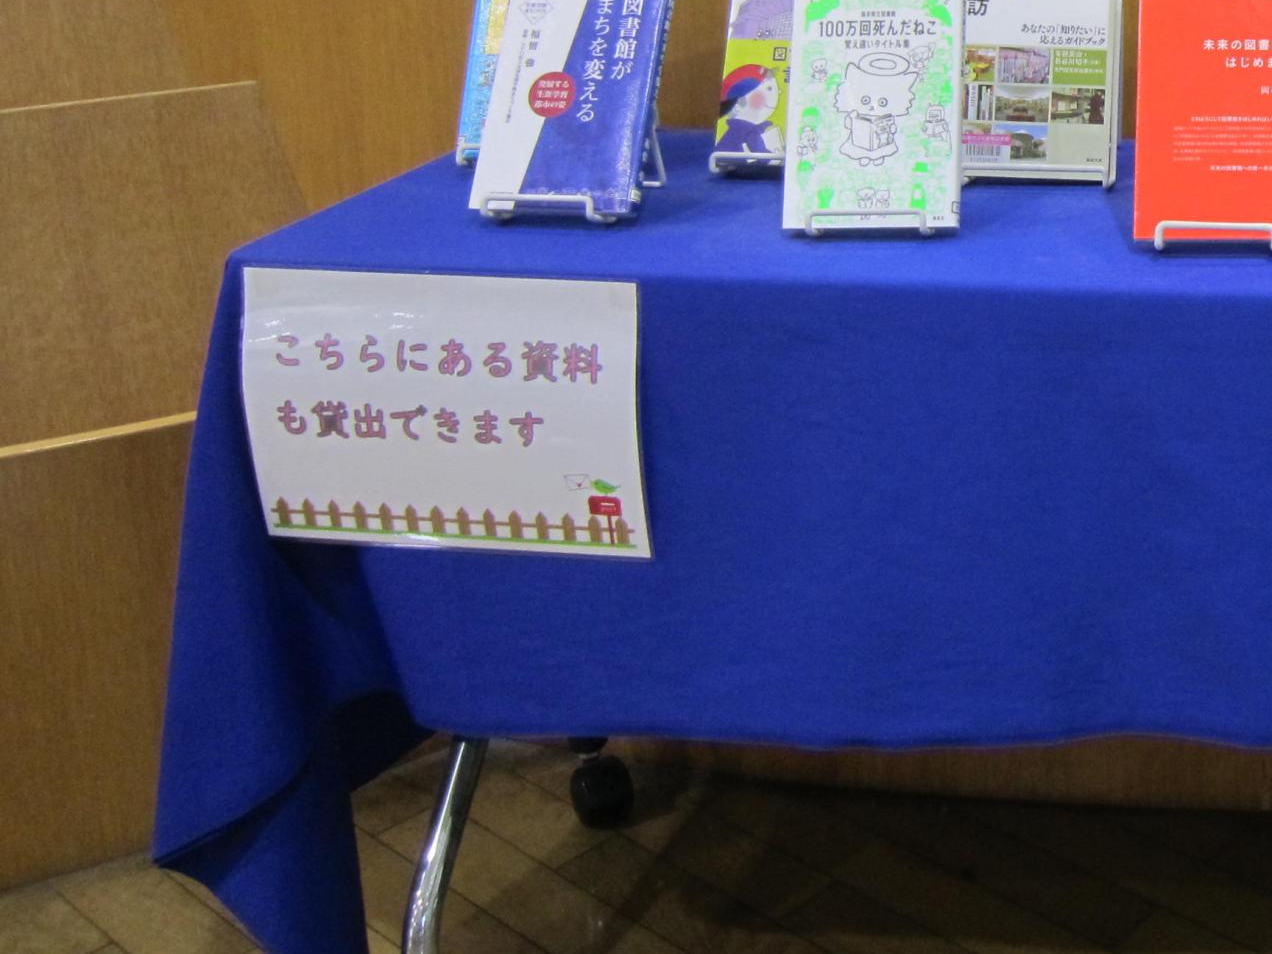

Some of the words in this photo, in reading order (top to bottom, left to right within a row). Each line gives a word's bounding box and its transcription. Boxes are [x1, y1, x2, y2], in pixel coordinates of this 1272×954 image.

[819, 19, 937, 37] 100万回死んだねこ
[1021, 23, 1106, 35] あなたの「知りたい」に
[1039, 35, 1106, 45] 応えるガイドブック
[275, 332, 602, 384] こちらにある資料
[276, 399, 544, 447] も貸出できます
